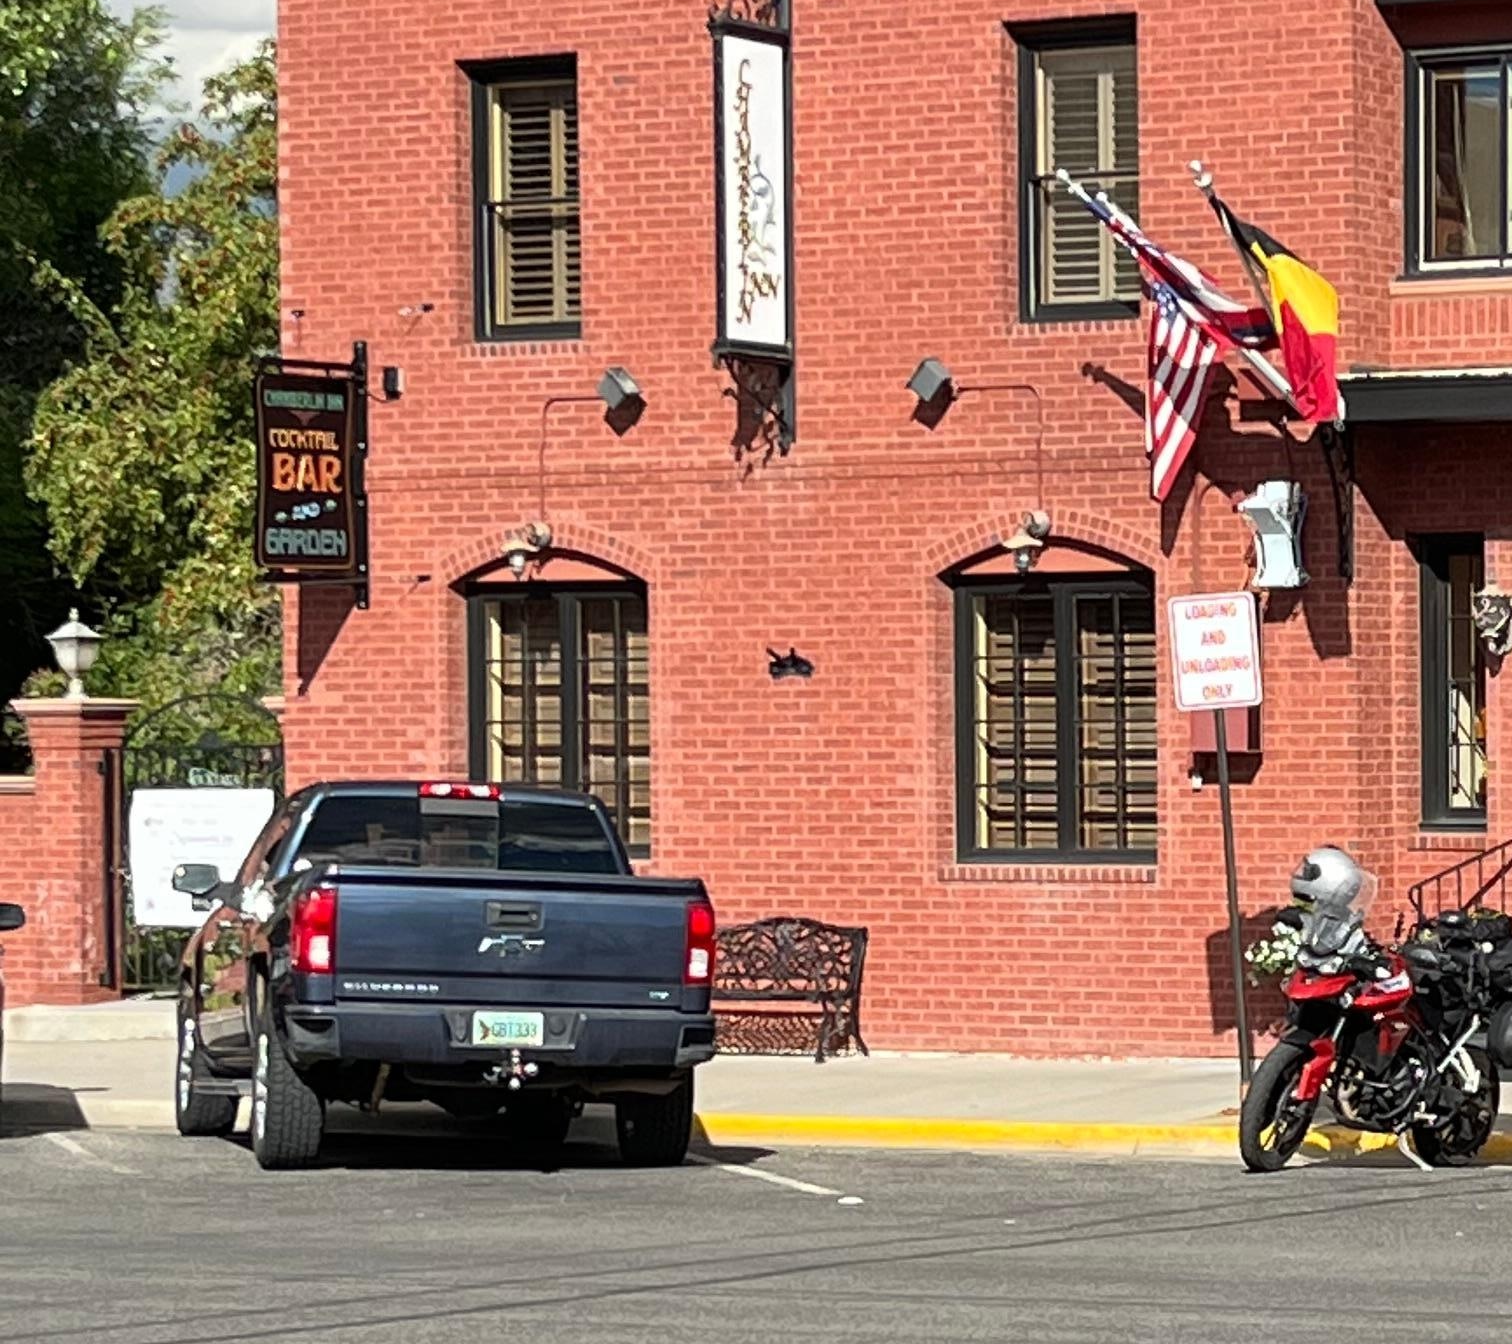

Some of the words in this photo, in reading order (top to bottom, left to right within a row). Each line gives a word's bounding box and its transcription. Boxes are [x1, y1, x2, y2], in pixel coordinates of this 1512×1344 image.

[268, 428, 340, 452] COCKTAIL
[272, 452, 343, 494] BAR
[265, 527, 348, 557] GARDEN
[1185, 602, 1237, 620] LOADING
[1201, 629, 1226, 646] AND
[1181, 655, 1250, 674] UNLOADING
[1202, 683, 1233, 700] ONLY
